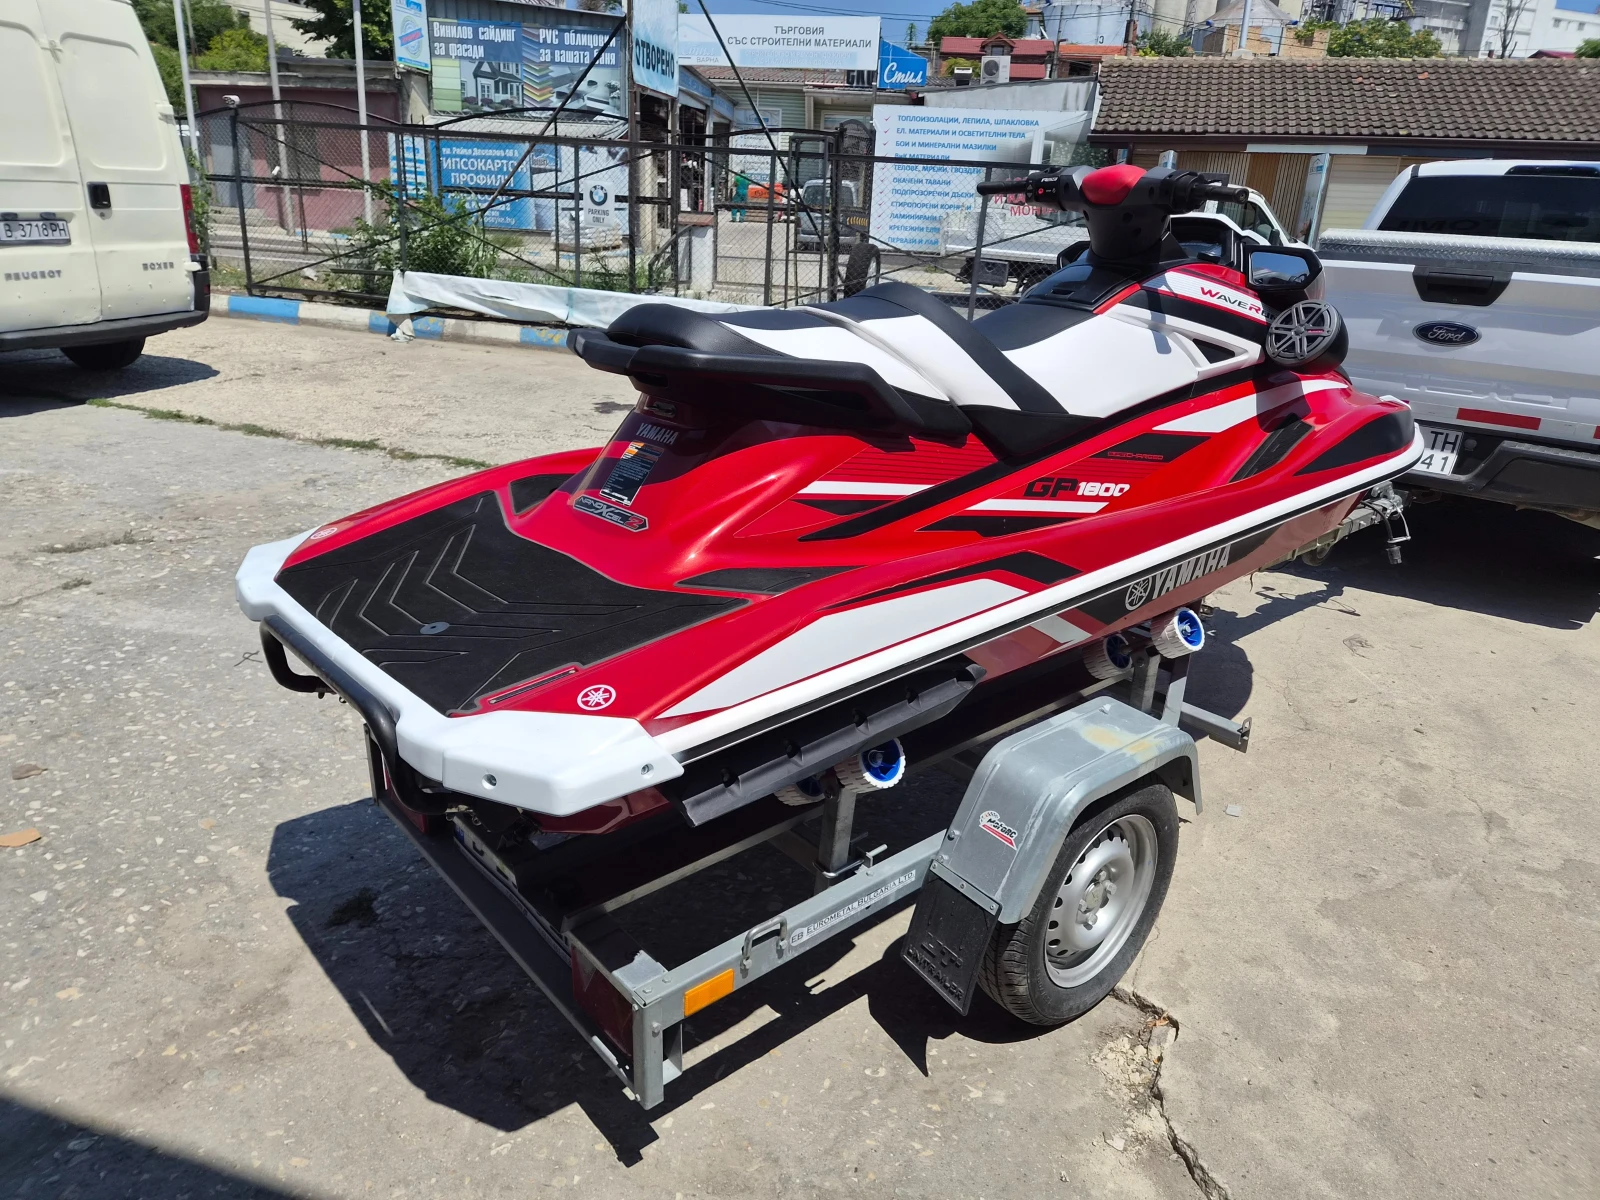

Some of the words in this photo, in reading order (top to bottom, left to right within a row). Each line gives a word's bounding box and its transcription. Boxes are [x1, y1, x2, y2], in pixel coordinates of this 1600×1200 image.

[433, 22, 473, 39] Винилов
[478, 25, 516, 42] сайдинг
[539, 28, 558, 44] PVC
[774, 26, 825, 35] ТЪРГОВИЯ
[434, 42, 446, 55] за
[449, 43, 484, 59] фасади
[727, 37, 748, 45] СЪС
[750, 37, 812, 47] СТРОИТЕЛНИ
[814, 38, 872, 48] МАТЕРИАЛИ
[539, 49, 551, 62] за
[554, 50, 590, 64] вашата
[635, 38, 675, 80] ОТВОРЕНО
[696, 56, 719, 64] ВАРНА
[883, 62, 922, 83] Стил
[897, 115, 960, 124] ТОПЛОИЗОЛАЦИИ,
[962, 118, 992, 126] ЛЕПИЛА,
[993, 119, 1039, 127] ШПАКЛОВКА
[451, 172, 514, 187] ПРОФИЛИ
[892, 177, 924, 185] ОКАЧЕНИ
[925, 178, 951, 186] ТАВАНИ
[891, 189, 950, 198] ПОДПРОЗОРЕЧНИ
[588, 208, 610, 216] PARKING
[18, 222, 49, 238] 3718
[142, 261, 175, 271] BOXER
[4, 269, 62, 281] PEUGEOT
[1427, 324, 1467, 343] Ford
[636, 422, 679, 445] YAMAHA
[1430, 430, 1460, 454] TH
[1420, 453, 1449, 472] 41
[1024, 477, 1131, 498] GP1800
[1151, 543, 1231, 600] YAMAHA
[791, 931, 805, 944] EB
[806, 903, 856, 933] EUROMETAL
[857, 881, 897, 907] BULGARIA
